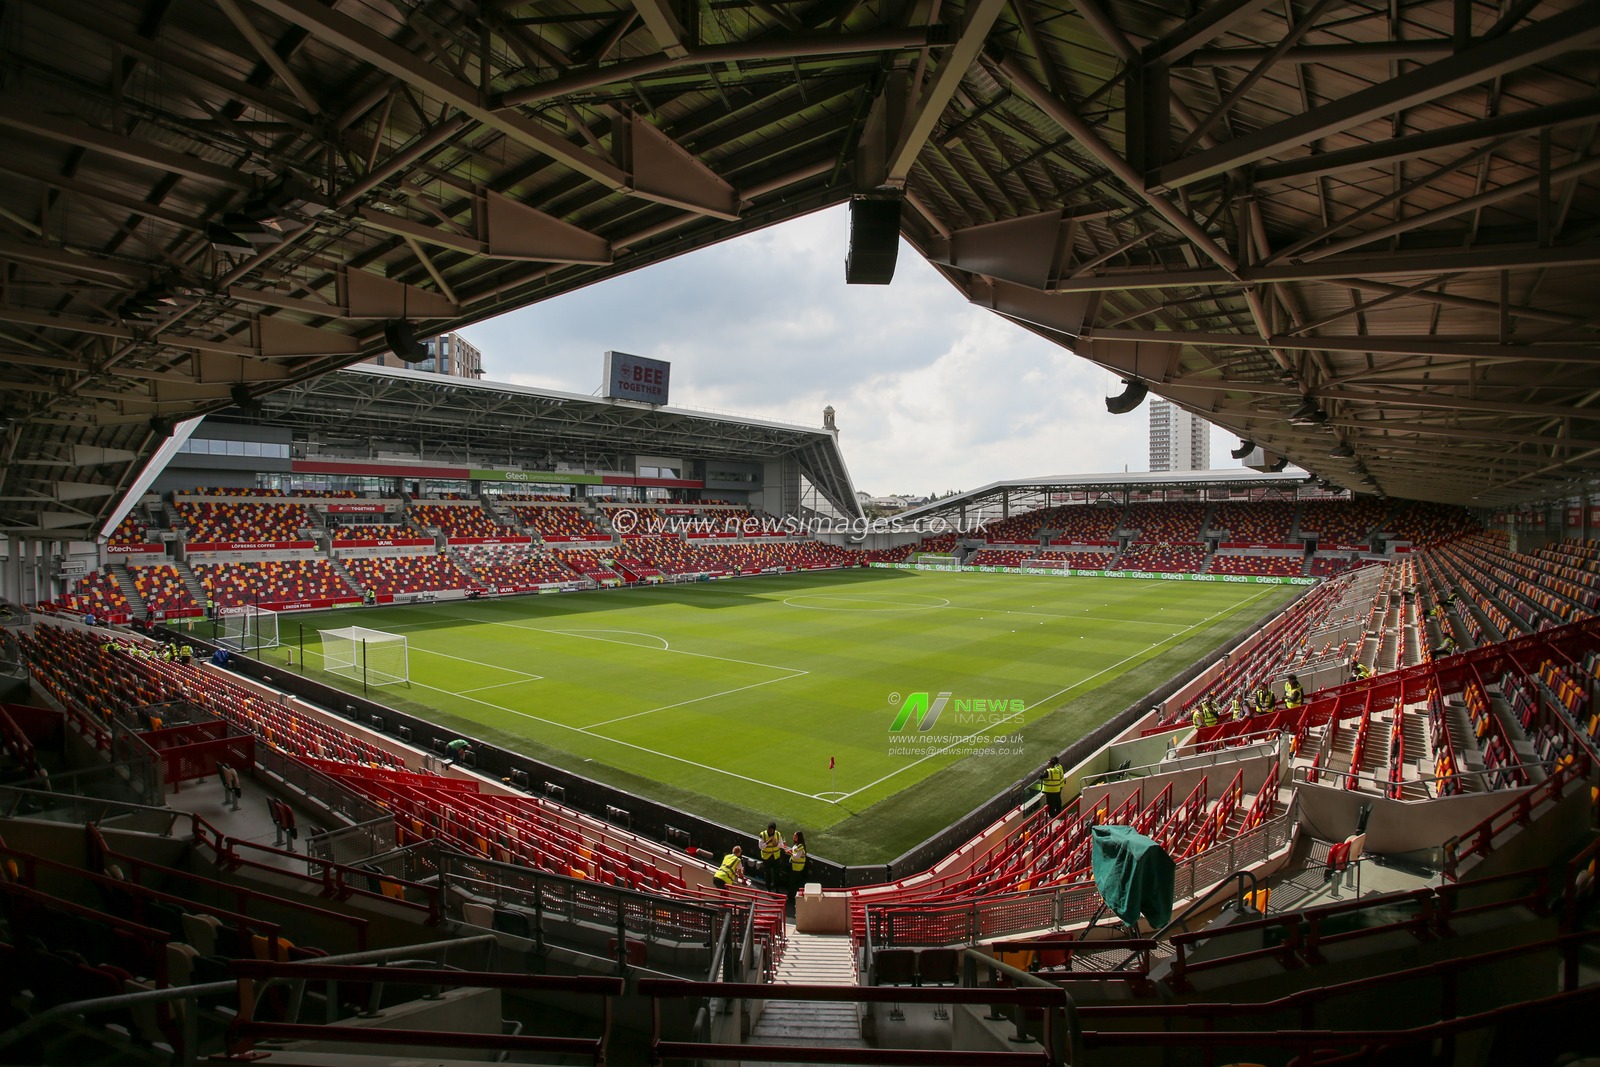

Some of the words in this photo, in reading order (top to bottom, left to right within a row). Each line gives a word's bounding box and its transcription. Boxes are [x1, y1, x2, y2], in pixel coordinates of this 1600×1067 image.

[633, 365, 663, 385] BEE
[618, 381, 662, 396] TOGETHER
[506, 472, 528, 480] Gtech
